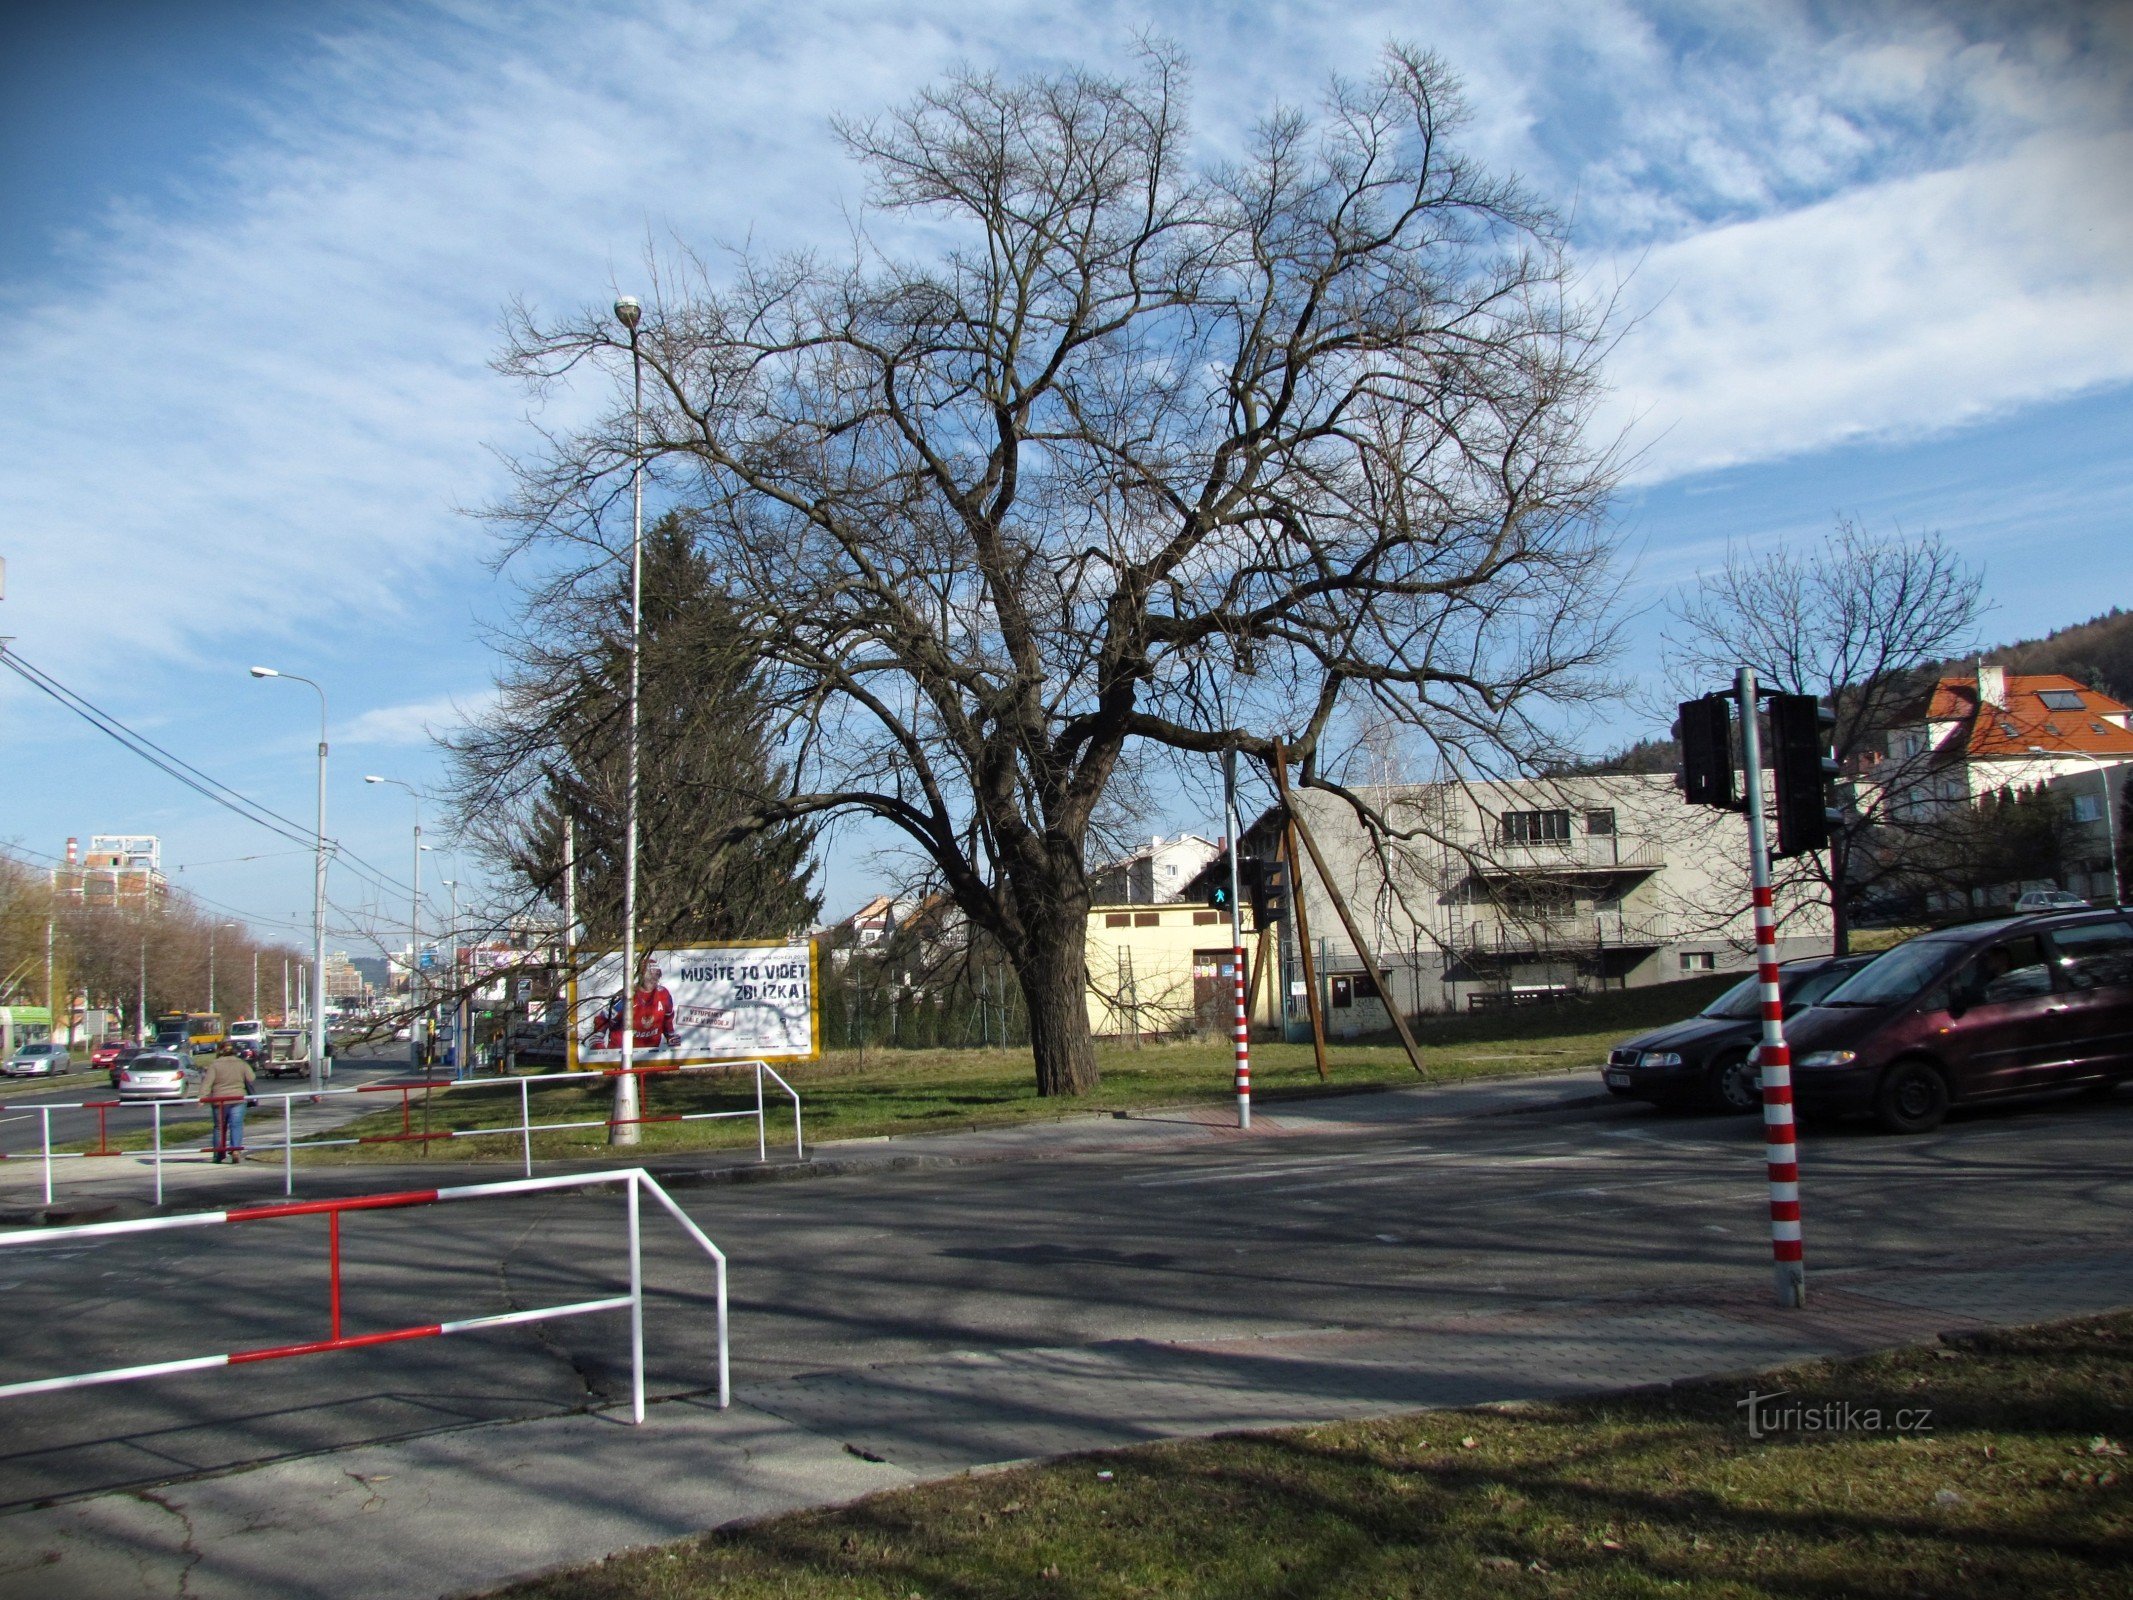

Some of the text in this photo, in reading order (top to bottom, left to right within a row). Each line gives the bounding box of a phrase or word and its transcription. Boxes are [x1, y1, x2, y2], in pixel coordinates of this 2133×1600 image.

[681, 961, 806, 982] MUSÍTE TO VIDĚT
[657, 1001, 664, 1011] A
